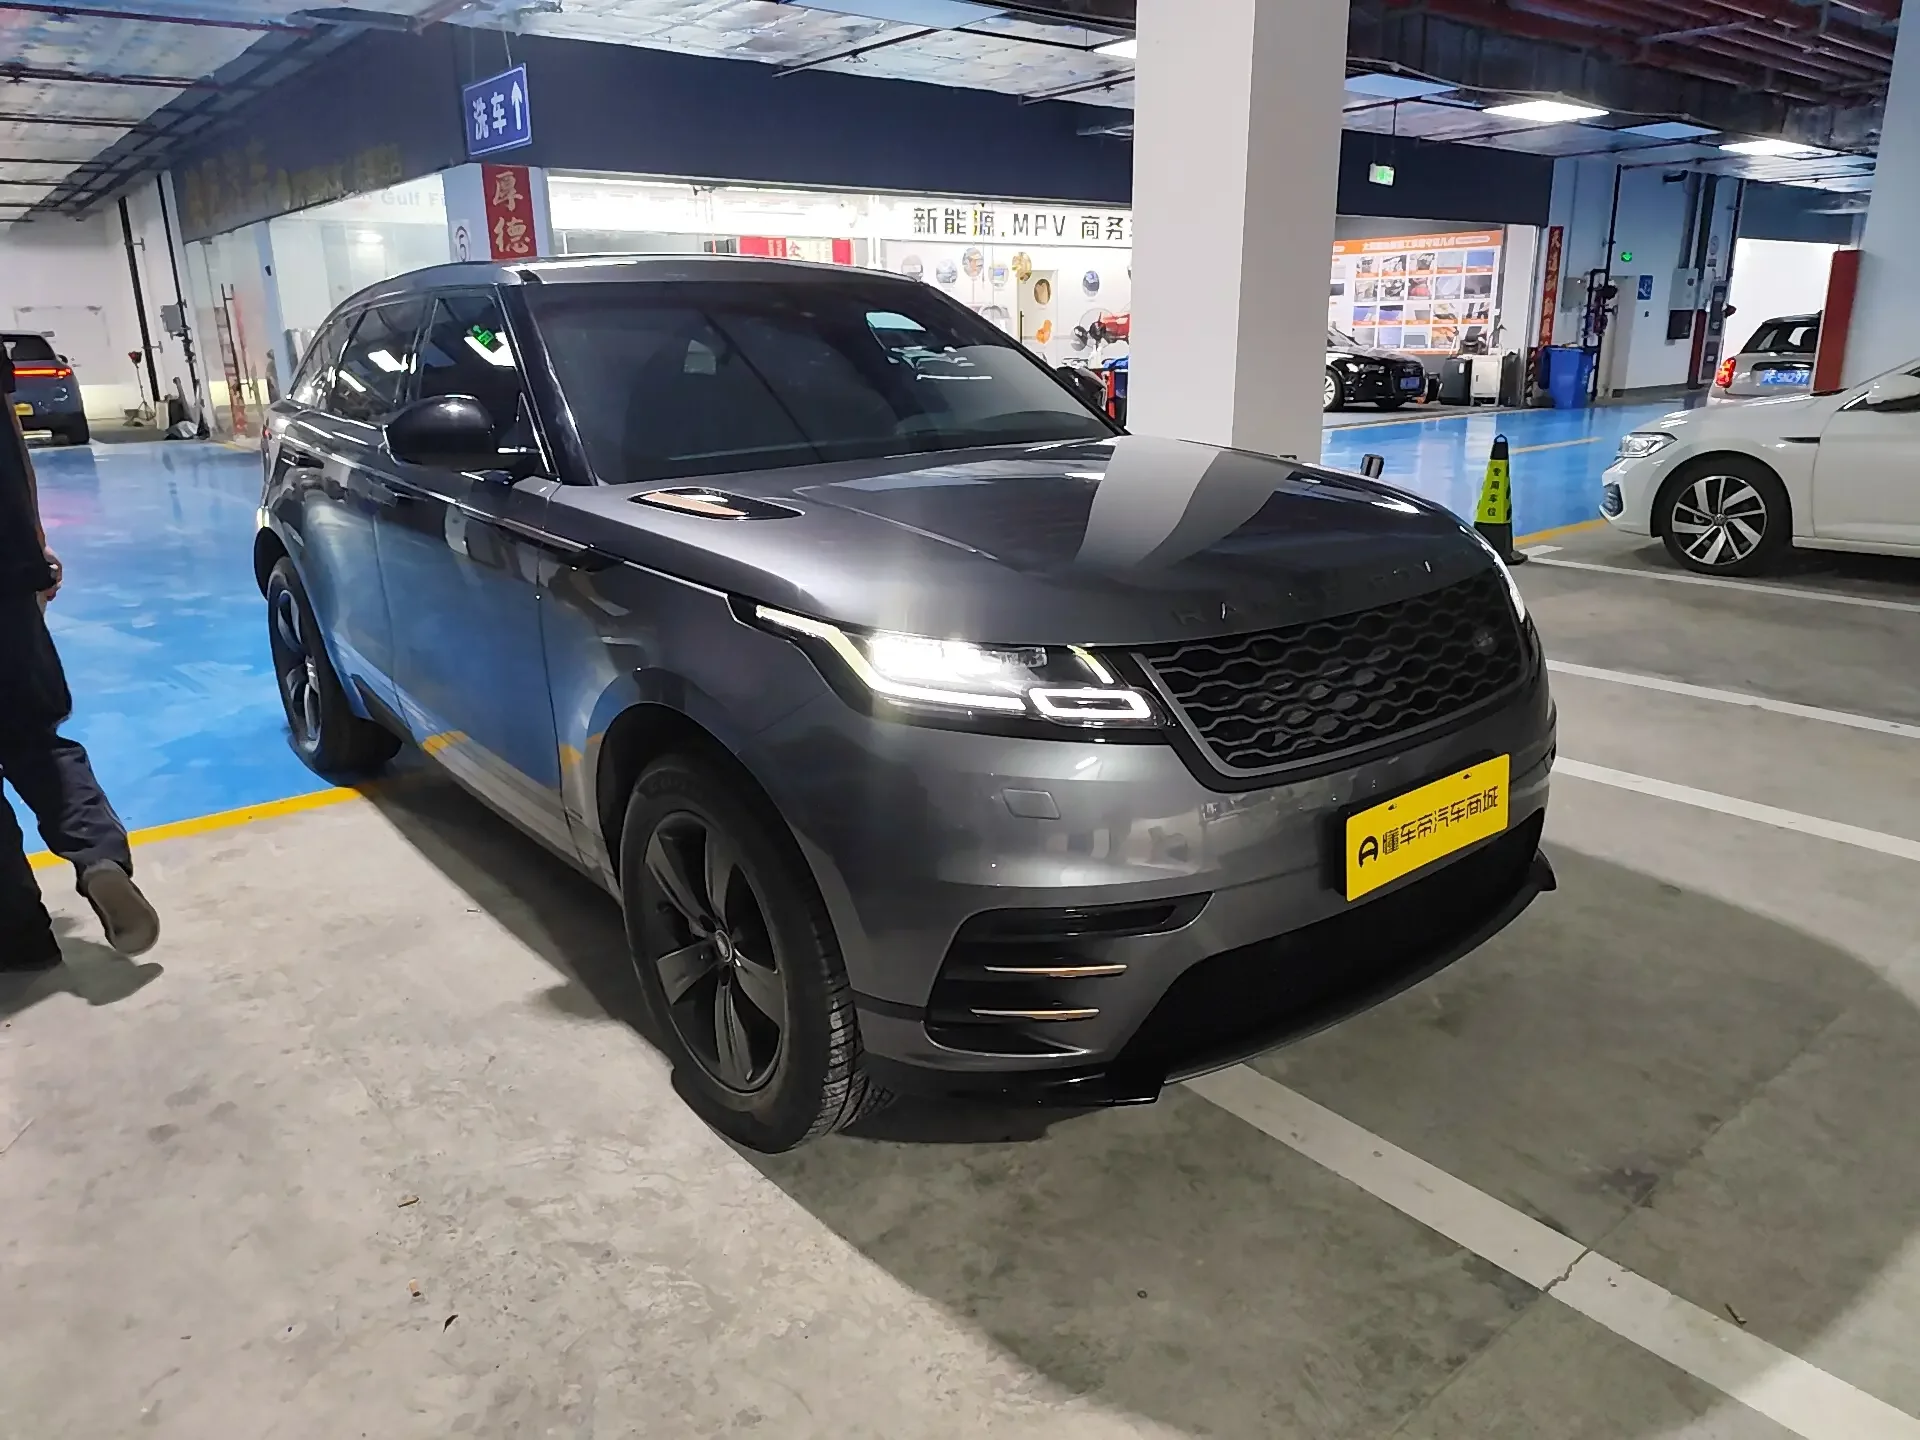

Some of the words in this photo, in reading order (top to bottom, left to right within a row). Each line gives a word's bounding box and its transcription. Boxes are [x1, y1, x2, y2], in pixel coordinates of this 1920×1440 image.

[472, 91, 507, 140] 洗车
[380, 190, 421, 206] Gulf
[492, 170, 531, 254] 厚德
[1081, 215, 1132, 241] 商务
[1382, 785, 1499, 856] 懂车帝汽车商城
